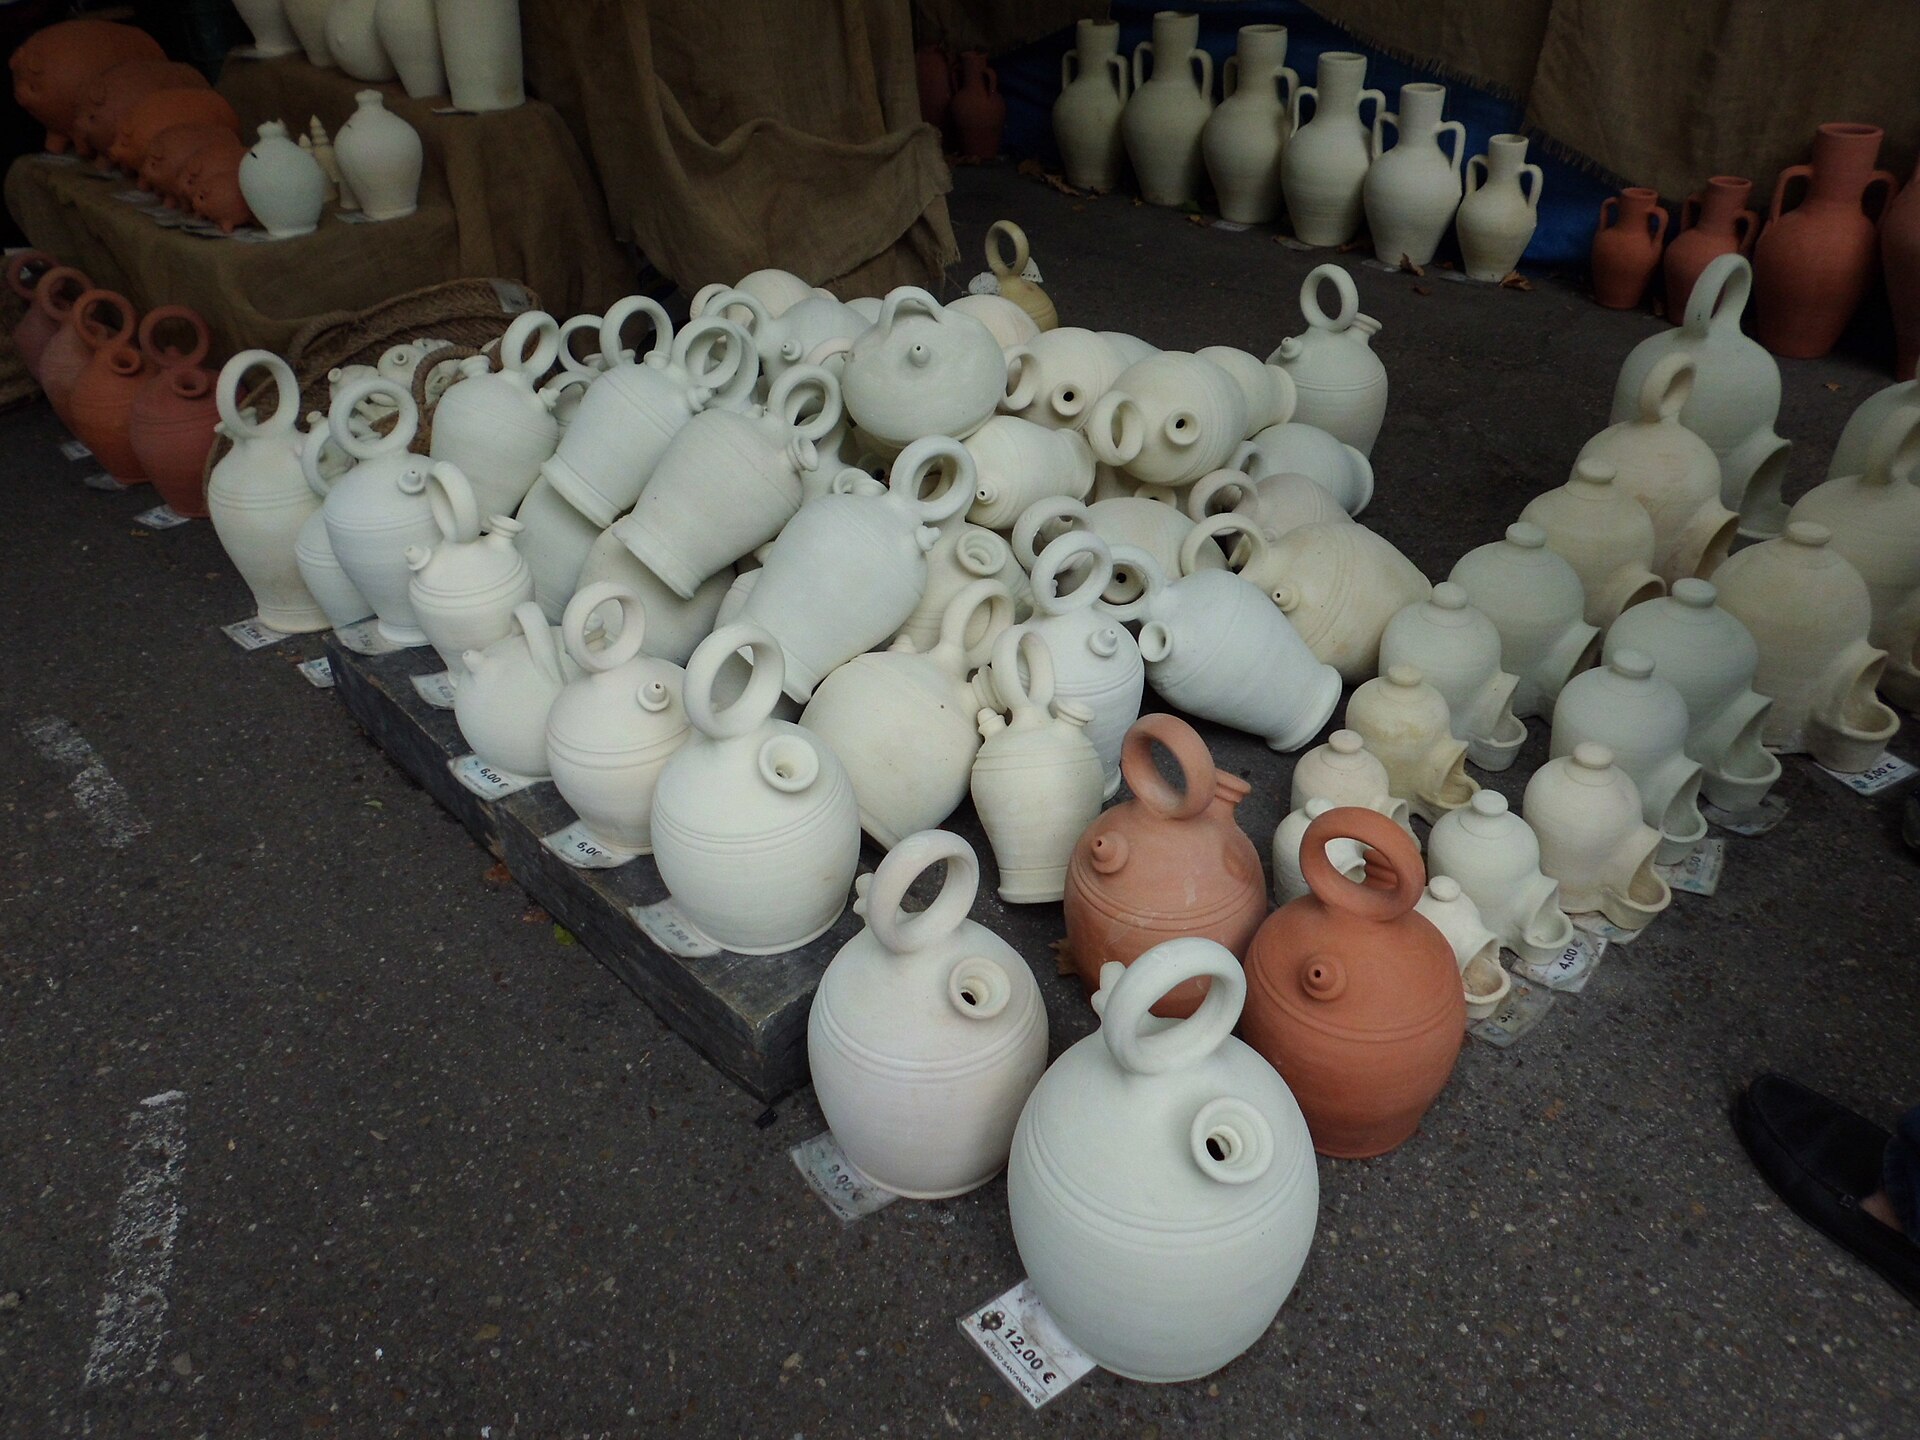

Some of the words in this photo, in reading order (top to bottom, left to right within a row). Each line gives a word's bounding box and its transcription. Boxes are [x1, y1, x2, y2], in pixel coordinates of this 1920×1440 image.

[480, 767, 501, 784] 6,00
[1863, 767, 1888, 781] 9,00
[1885, 762, 1897, 770] €
[665, 921, 689, 941] 7,50
[1559, 948, 1578, 970] 4,00
[1572, 939, 1583, 949] €
[1005, 1327, 1044, 1370] 12,00
[1042, 1371, 1057, 1385] €
[1001, 1360, 1032, 1393] SANTANDER
